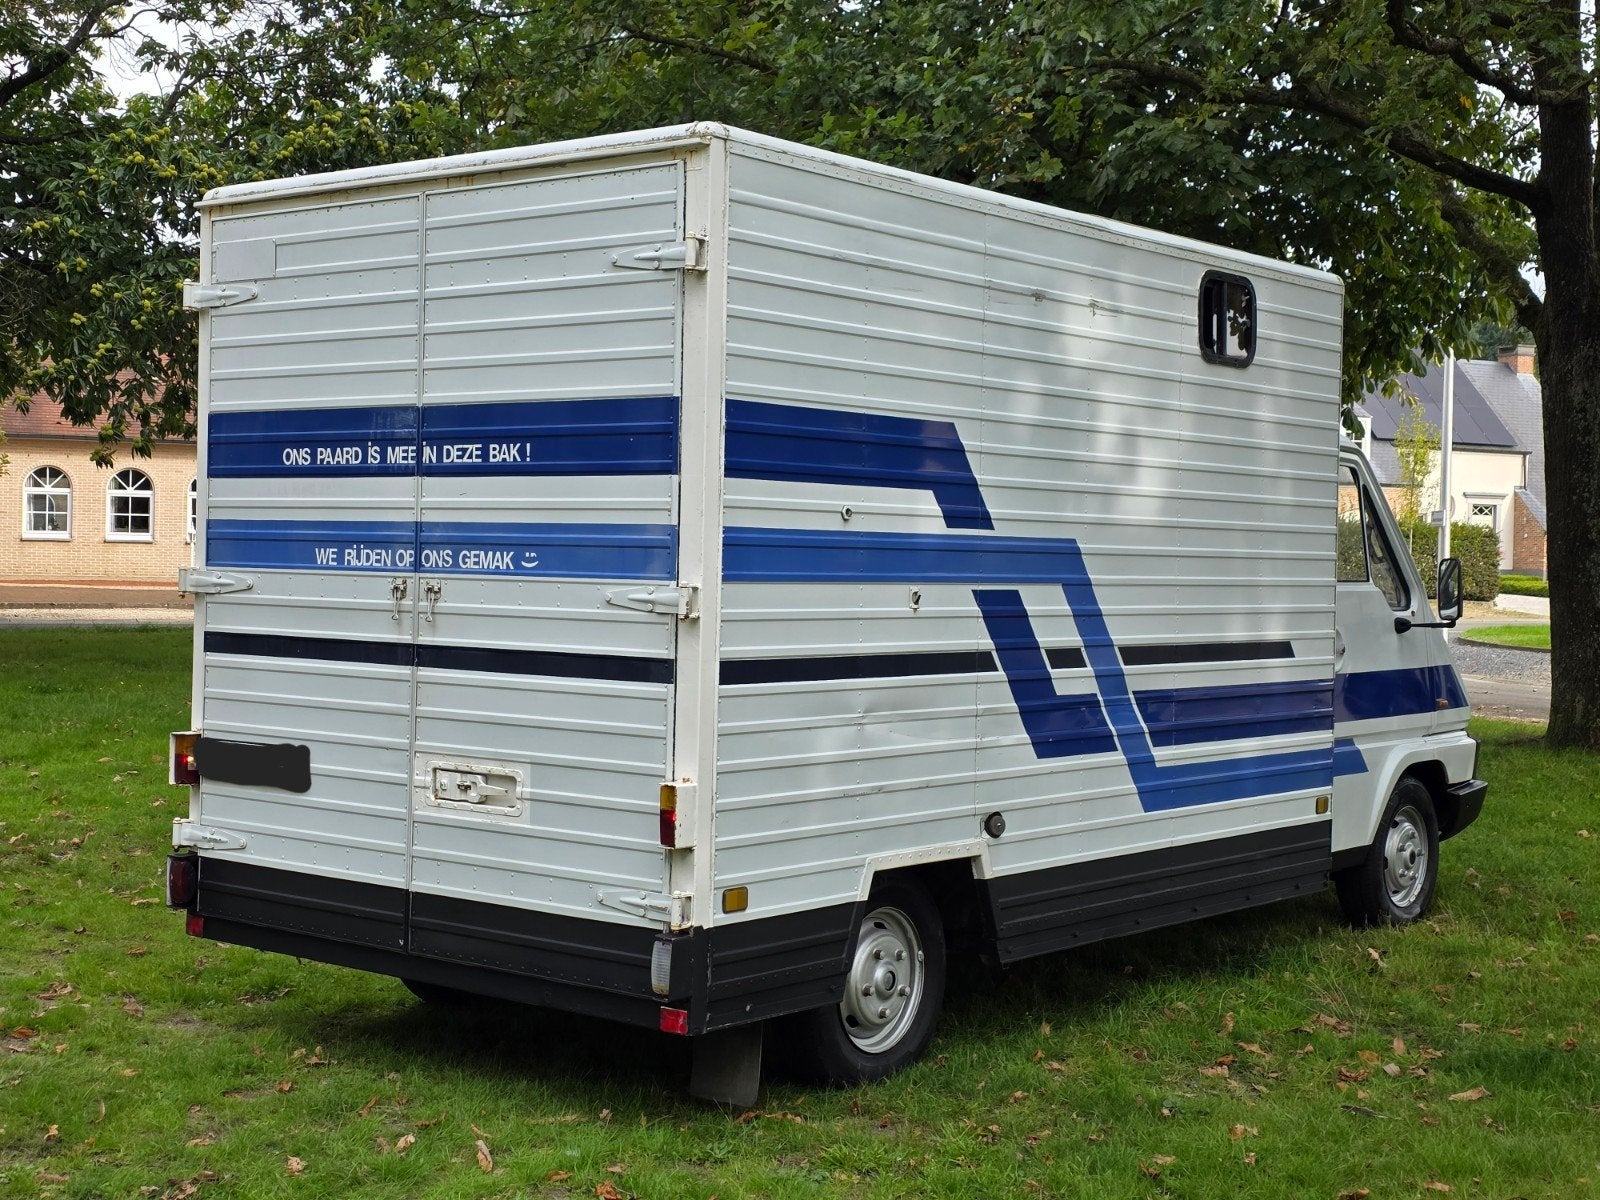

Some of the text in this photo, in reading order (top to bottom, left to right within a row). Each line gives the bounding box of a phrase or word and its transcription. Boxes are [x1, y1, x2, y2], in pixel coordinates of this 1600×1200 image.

[283, 448, 311, 465] ONS
[317, 447, 362, 465] PAARD
[387, 446, 416, 463] MEE
[443, 444, 482, 463] DEZE
[315, 548, 337, 565] WE
[396, 549, 414, 567] OP
[422, 549, 452, 567] ONS
[459, 551, 515, 570] GEMAK
